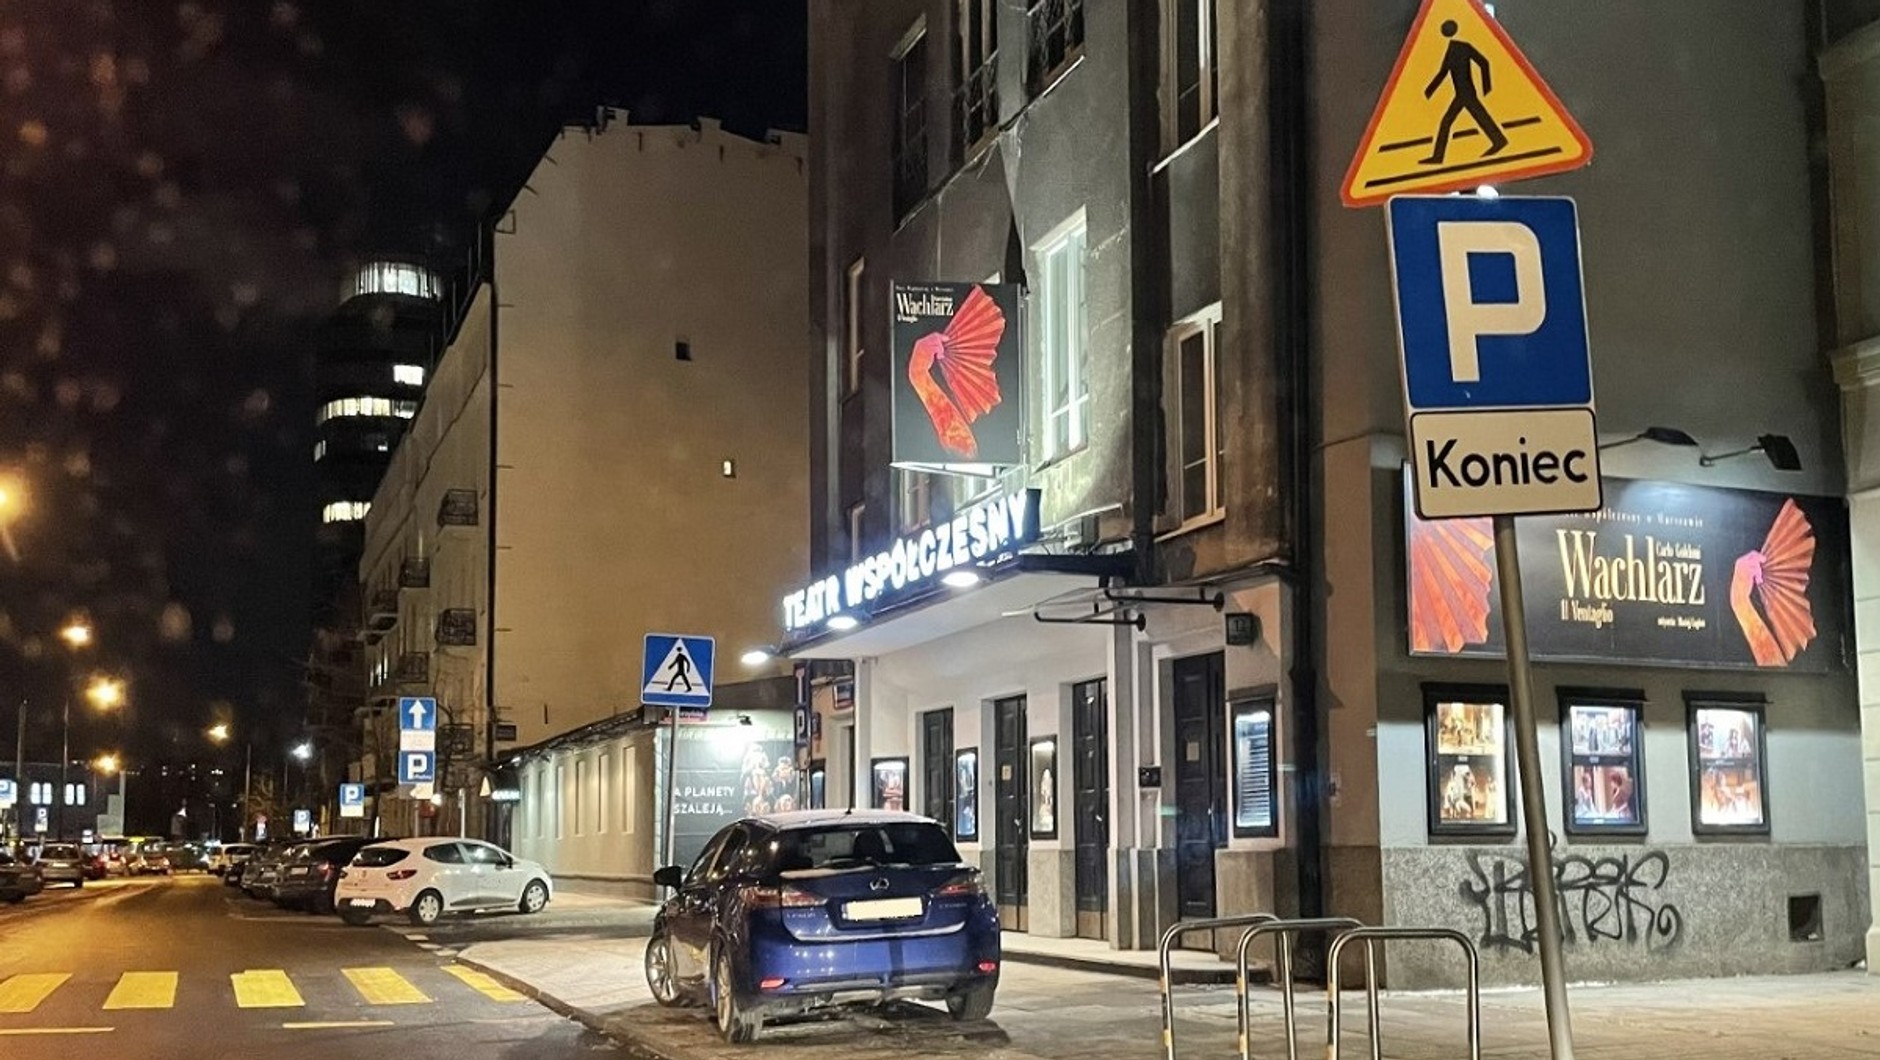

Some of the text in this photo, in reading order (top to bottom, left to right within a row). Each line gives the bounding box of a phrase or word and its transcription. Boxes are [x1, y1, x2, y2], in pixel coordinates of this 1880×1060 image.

[896, 293, 954, 316] Wachlarz
[1438, 221, 1546, 382] P
[1426, 437, 1588, 488] Koniec
[783, 488, 1028, 632] TEATR WSPÓŁCZESNY
[1556, 529, 1706, 605] Wachlarz
[407, 754, 428, 780] P
[345, 786, 359, 803] P
[684, 786, 736, 797] PLANETY
